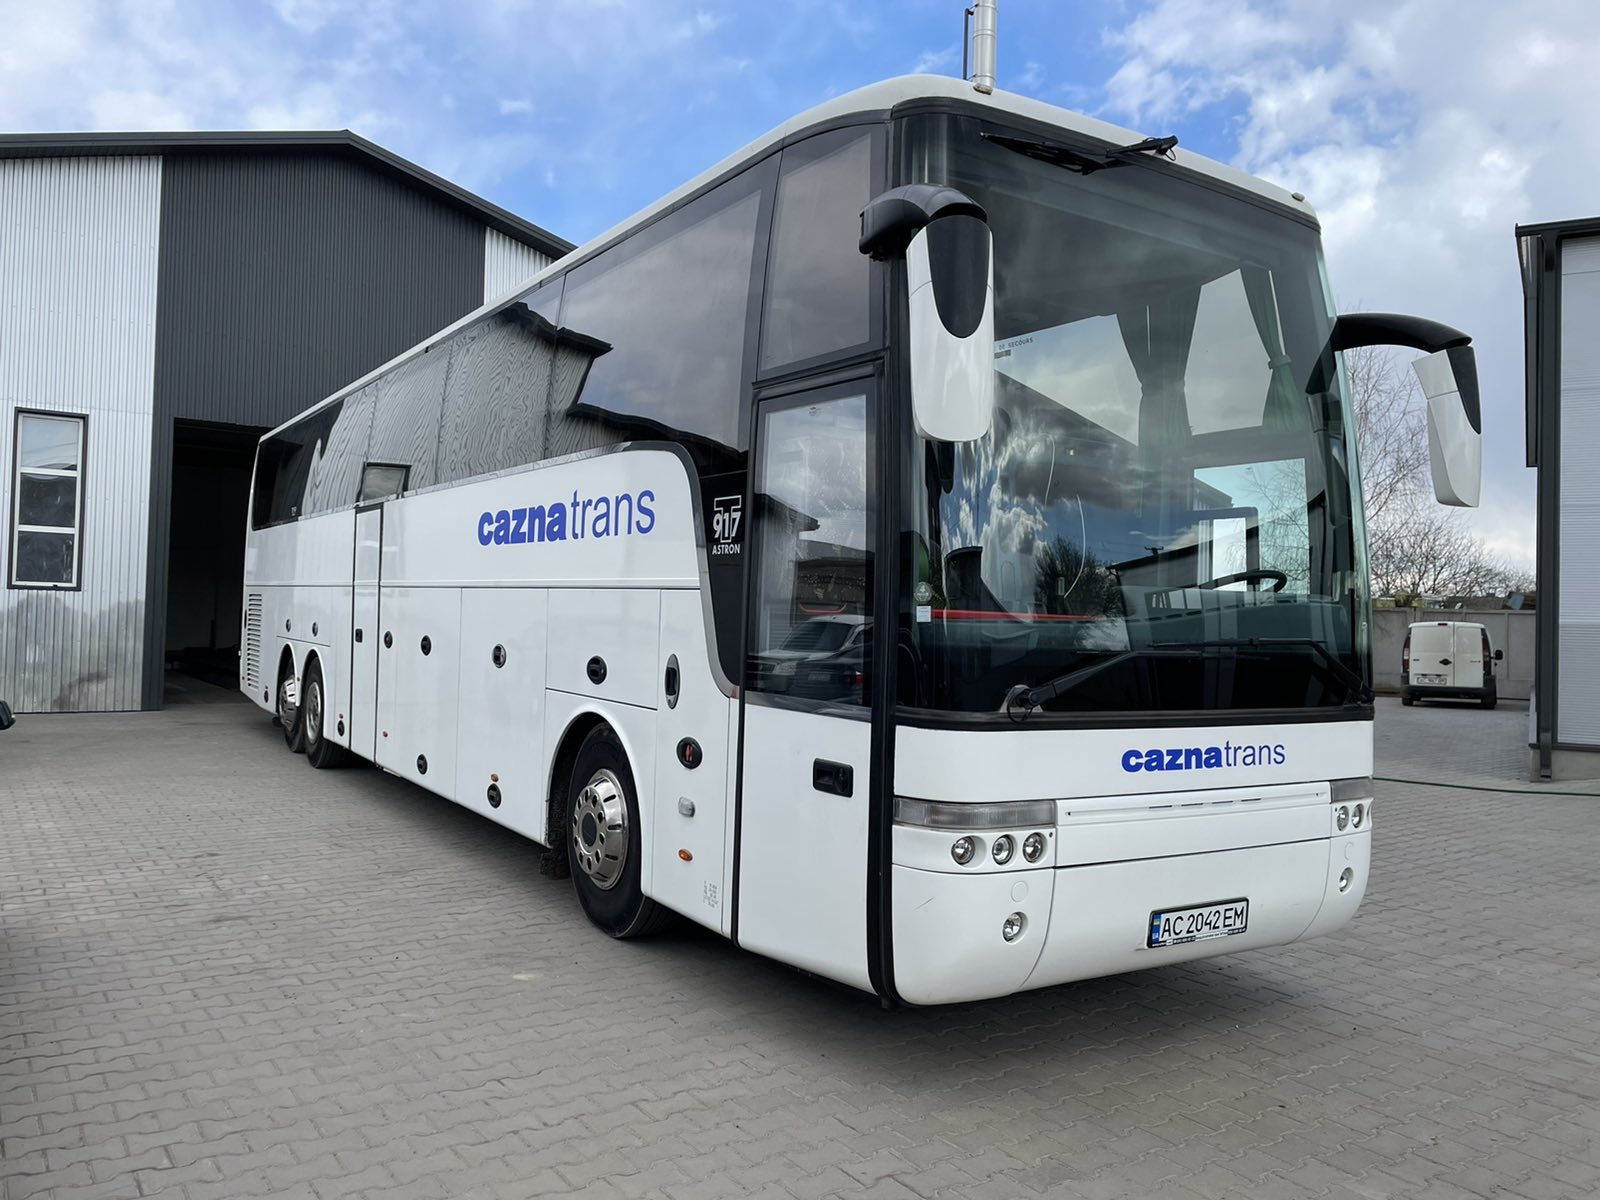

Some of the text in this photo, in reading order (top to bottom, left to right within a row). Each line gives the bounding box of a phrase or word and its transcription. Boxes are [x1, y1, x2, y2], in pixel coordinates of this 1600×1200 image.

[713, 511, 741, 538] 917
[712, 543, 740, 554] ASTRON
[1161, 916, 1184, 938] AC
[1186, 910, 1220, 934] 2042
[1223, 906, 1244, 928] EM
